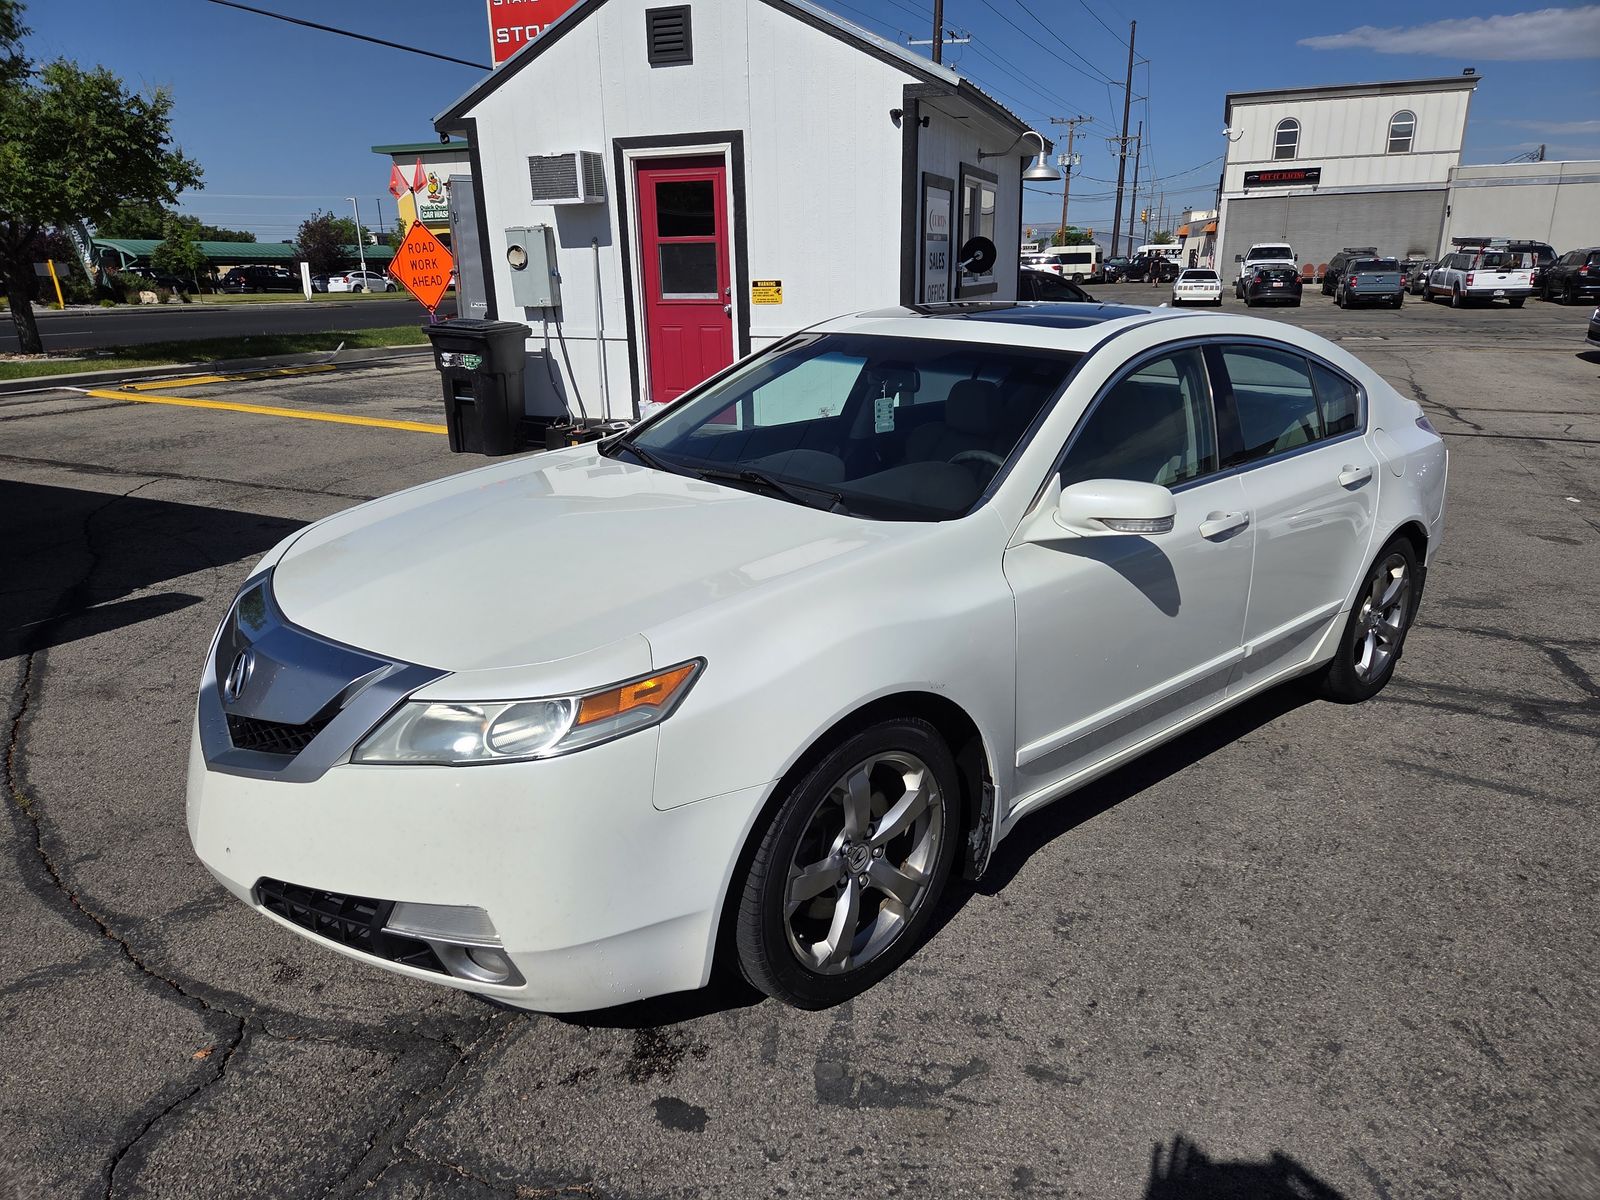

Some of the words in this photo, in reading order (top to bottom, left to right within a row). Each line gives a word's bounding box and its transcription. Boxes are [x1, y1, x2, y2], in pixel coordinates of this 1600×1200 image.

[496, 23, 552, 43] STO
[422, 211, 434, 219] CAR
[407, 241, 435, 254] ROAD
[410, 258, 438, 271] WORK
[929, 252, 945, 270] SALES
[412, 275, 443, 287] AHEAD
[928, 283, 945, 303] OFFICE
